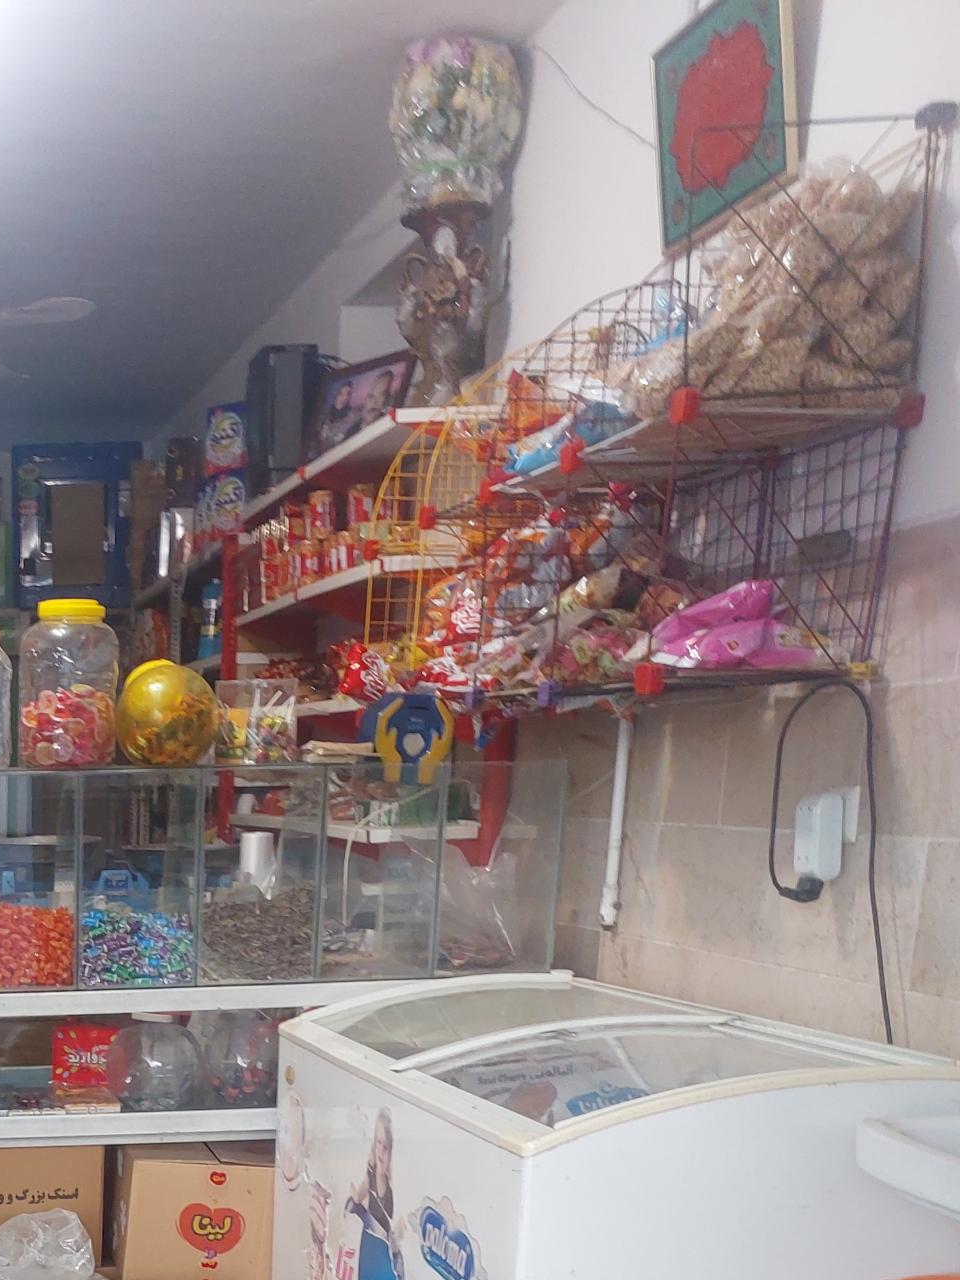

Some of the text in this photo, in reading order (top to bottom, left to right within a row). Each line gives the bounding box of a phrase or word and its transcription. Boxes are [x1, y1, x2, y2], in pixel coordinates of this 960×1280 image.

[6, 1193, 13, 1204] و
[15, 1188, 46, 1204] بزرگ
[47, 1188, 79, 1200] اسنک
[192, 1214, 233, 1241] لینا
[425, 1222, 468, 1277] paloma
